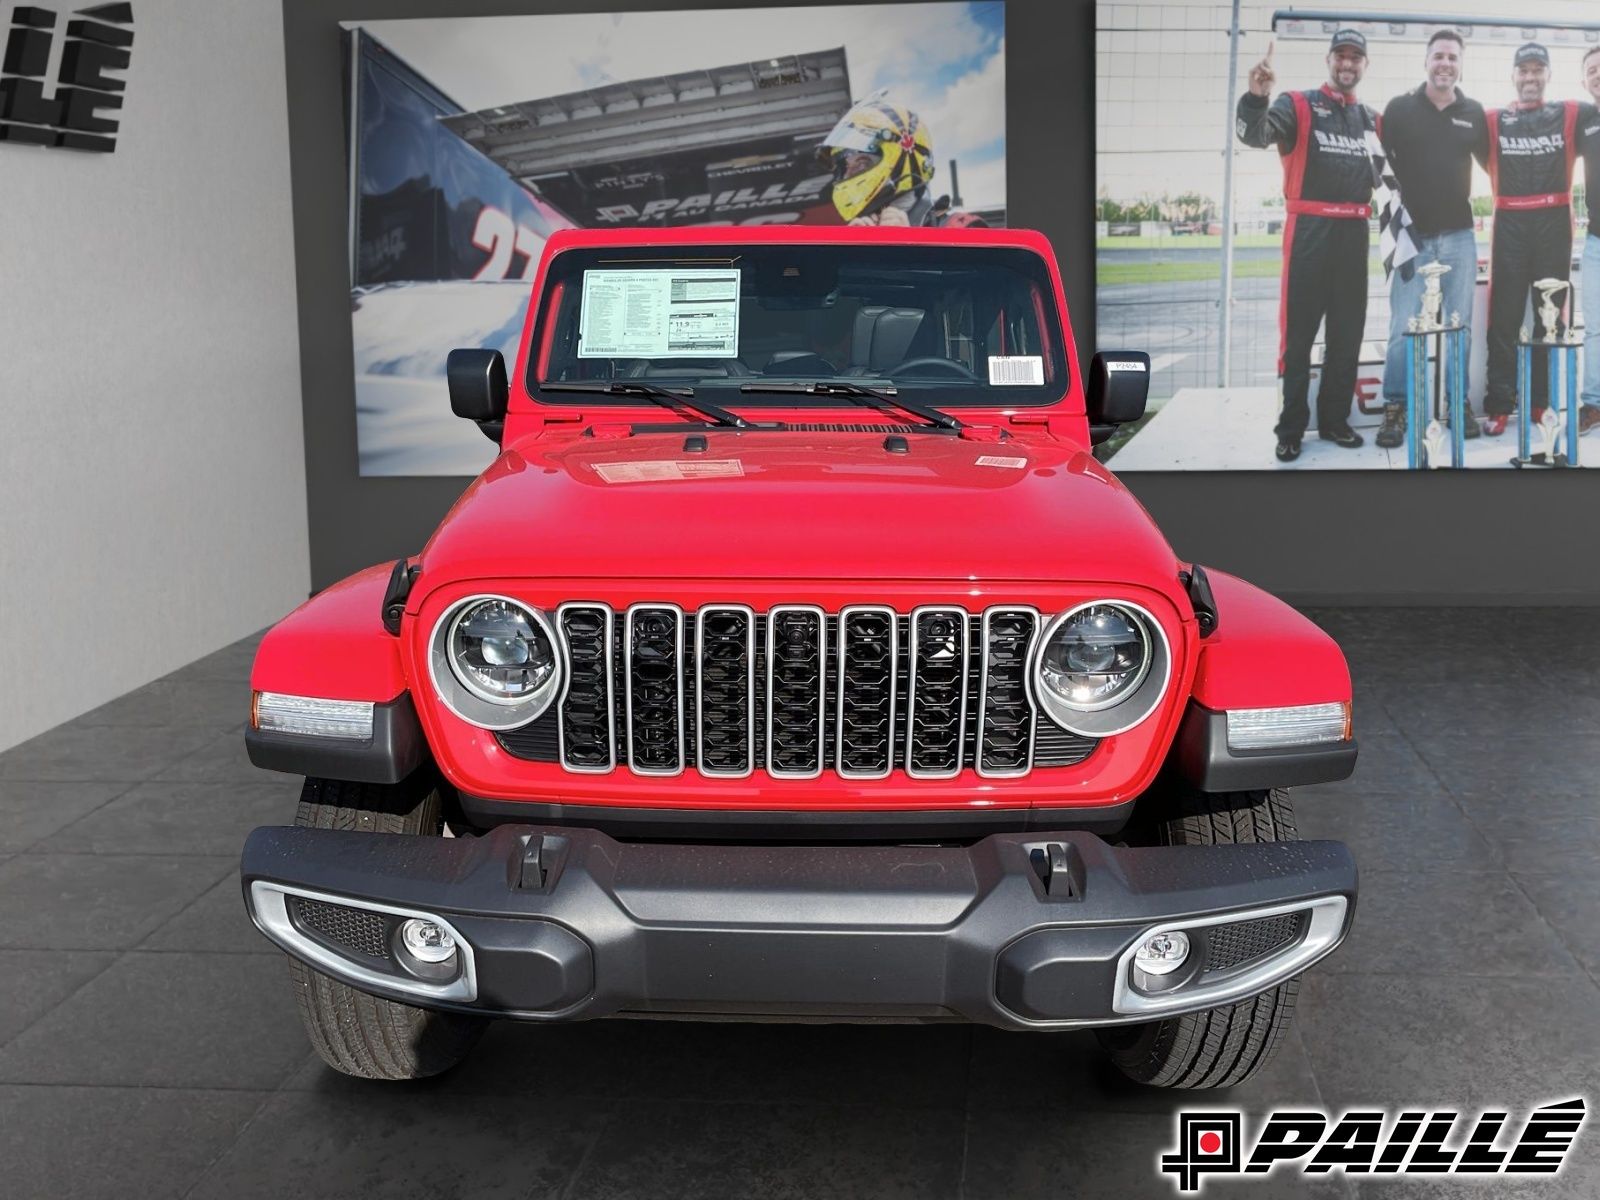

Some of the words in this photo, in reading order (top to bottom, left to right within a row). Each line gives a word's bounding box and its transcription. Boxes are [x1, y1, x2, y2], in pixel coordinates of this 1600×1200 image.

[707, 161, 794, 179] CHEVROLET
[672, 208, 706, 219] AU
[713, 194, 820, 213] CANADA
